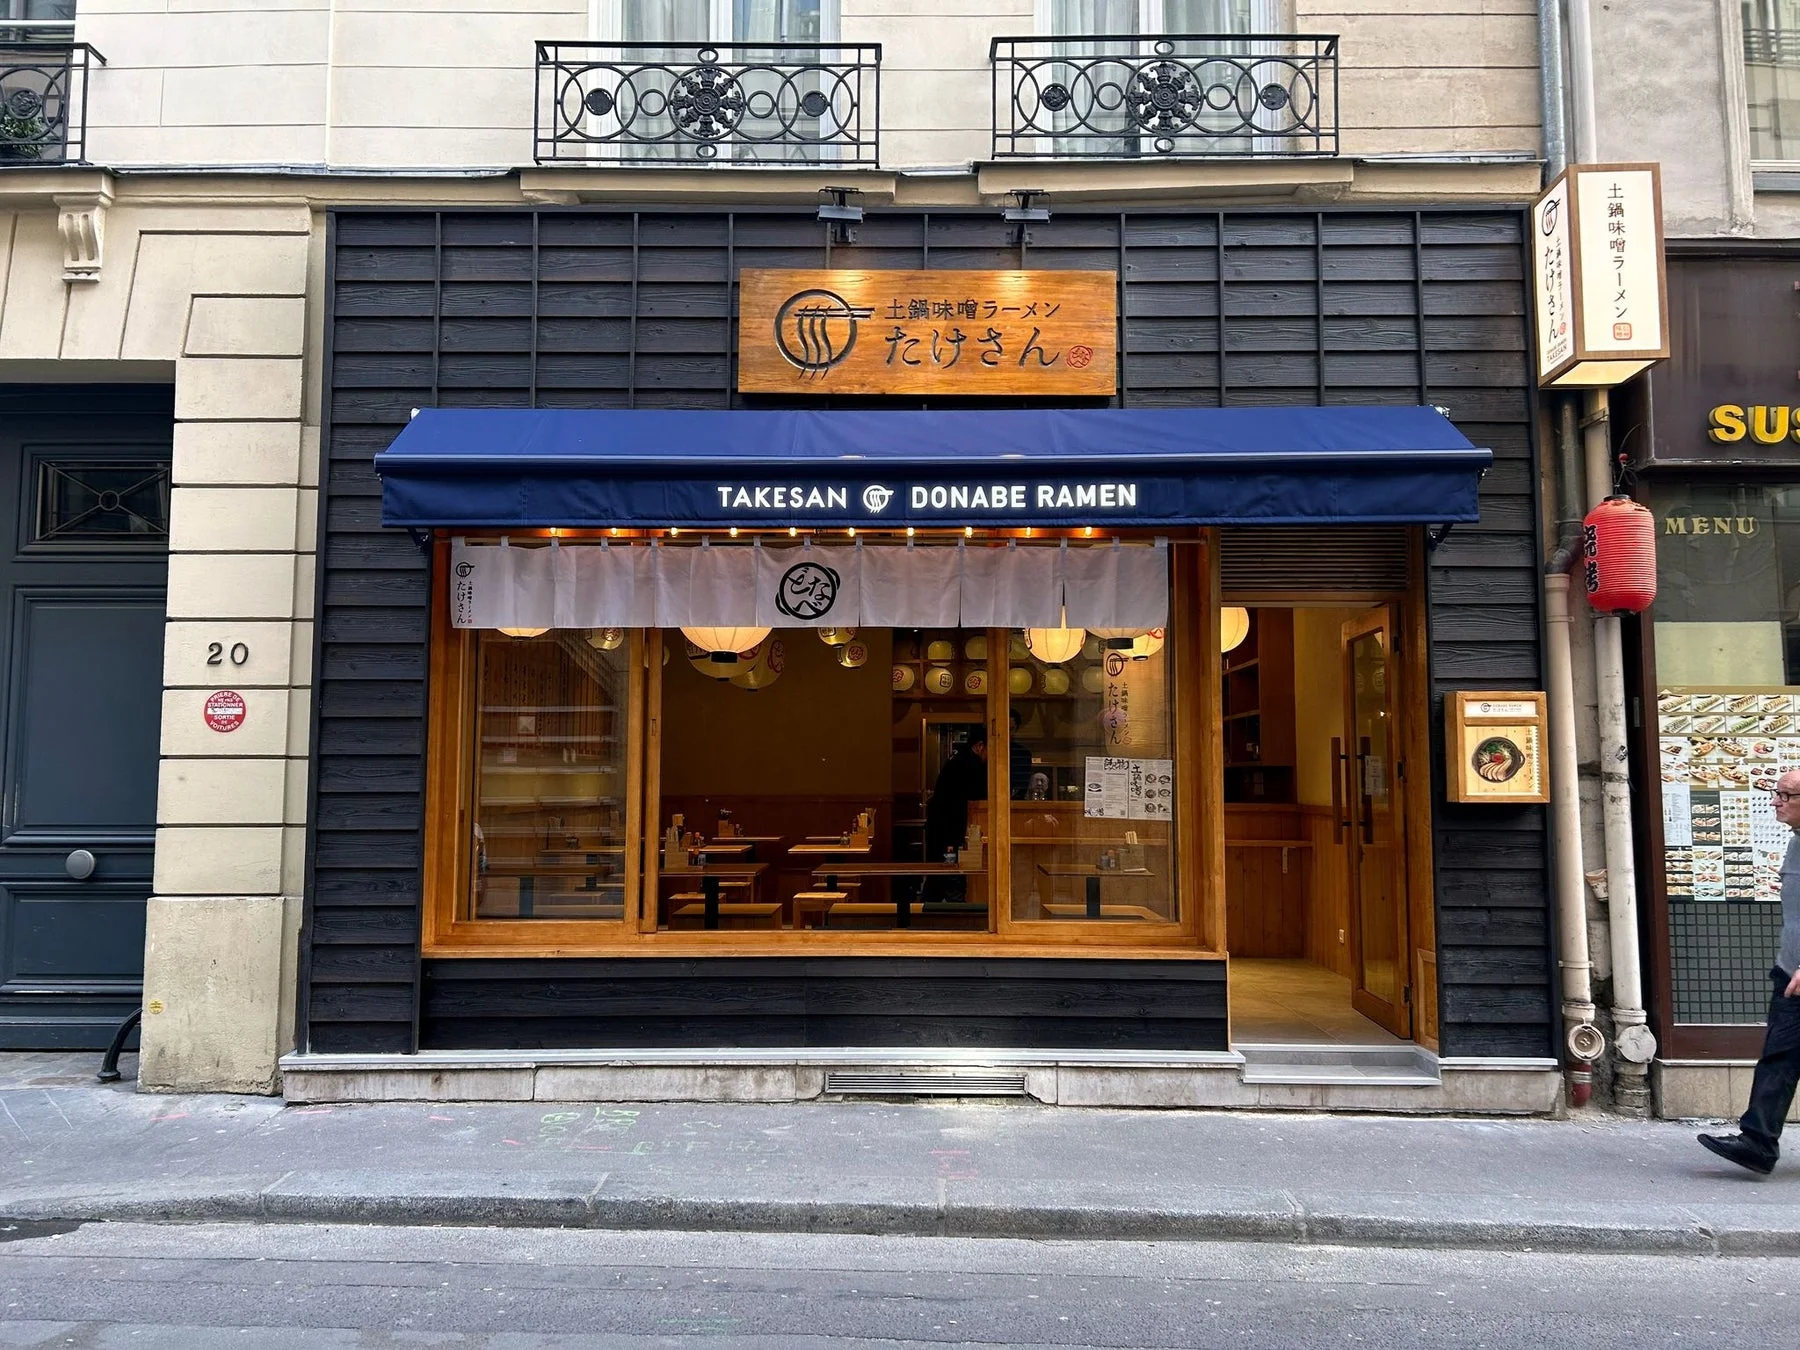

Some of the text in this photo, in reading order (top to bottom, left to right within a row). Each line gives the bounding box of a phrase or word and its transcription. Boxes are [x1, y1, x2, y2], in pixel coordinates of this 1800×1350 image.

[1607, 183, 1628, 319] 土鍋味噌ラーメン
[884, 298, 1061, 320] 土鍋味噌ラーメン
[1544, 246, 1559, 343] たけさん
[885, 326, 1061, 370] たけさん
[1708, 404, 1800, 444] SU
[717, 484, 1137, 509] TAKESAN DONABE RAMEN
[1665, 516, 1755, 536] MENU
[457, 581, 466, 624] たけさん
[207, 642, 249, 666] 20
[1108, 682, 1122, 745] たけさん
